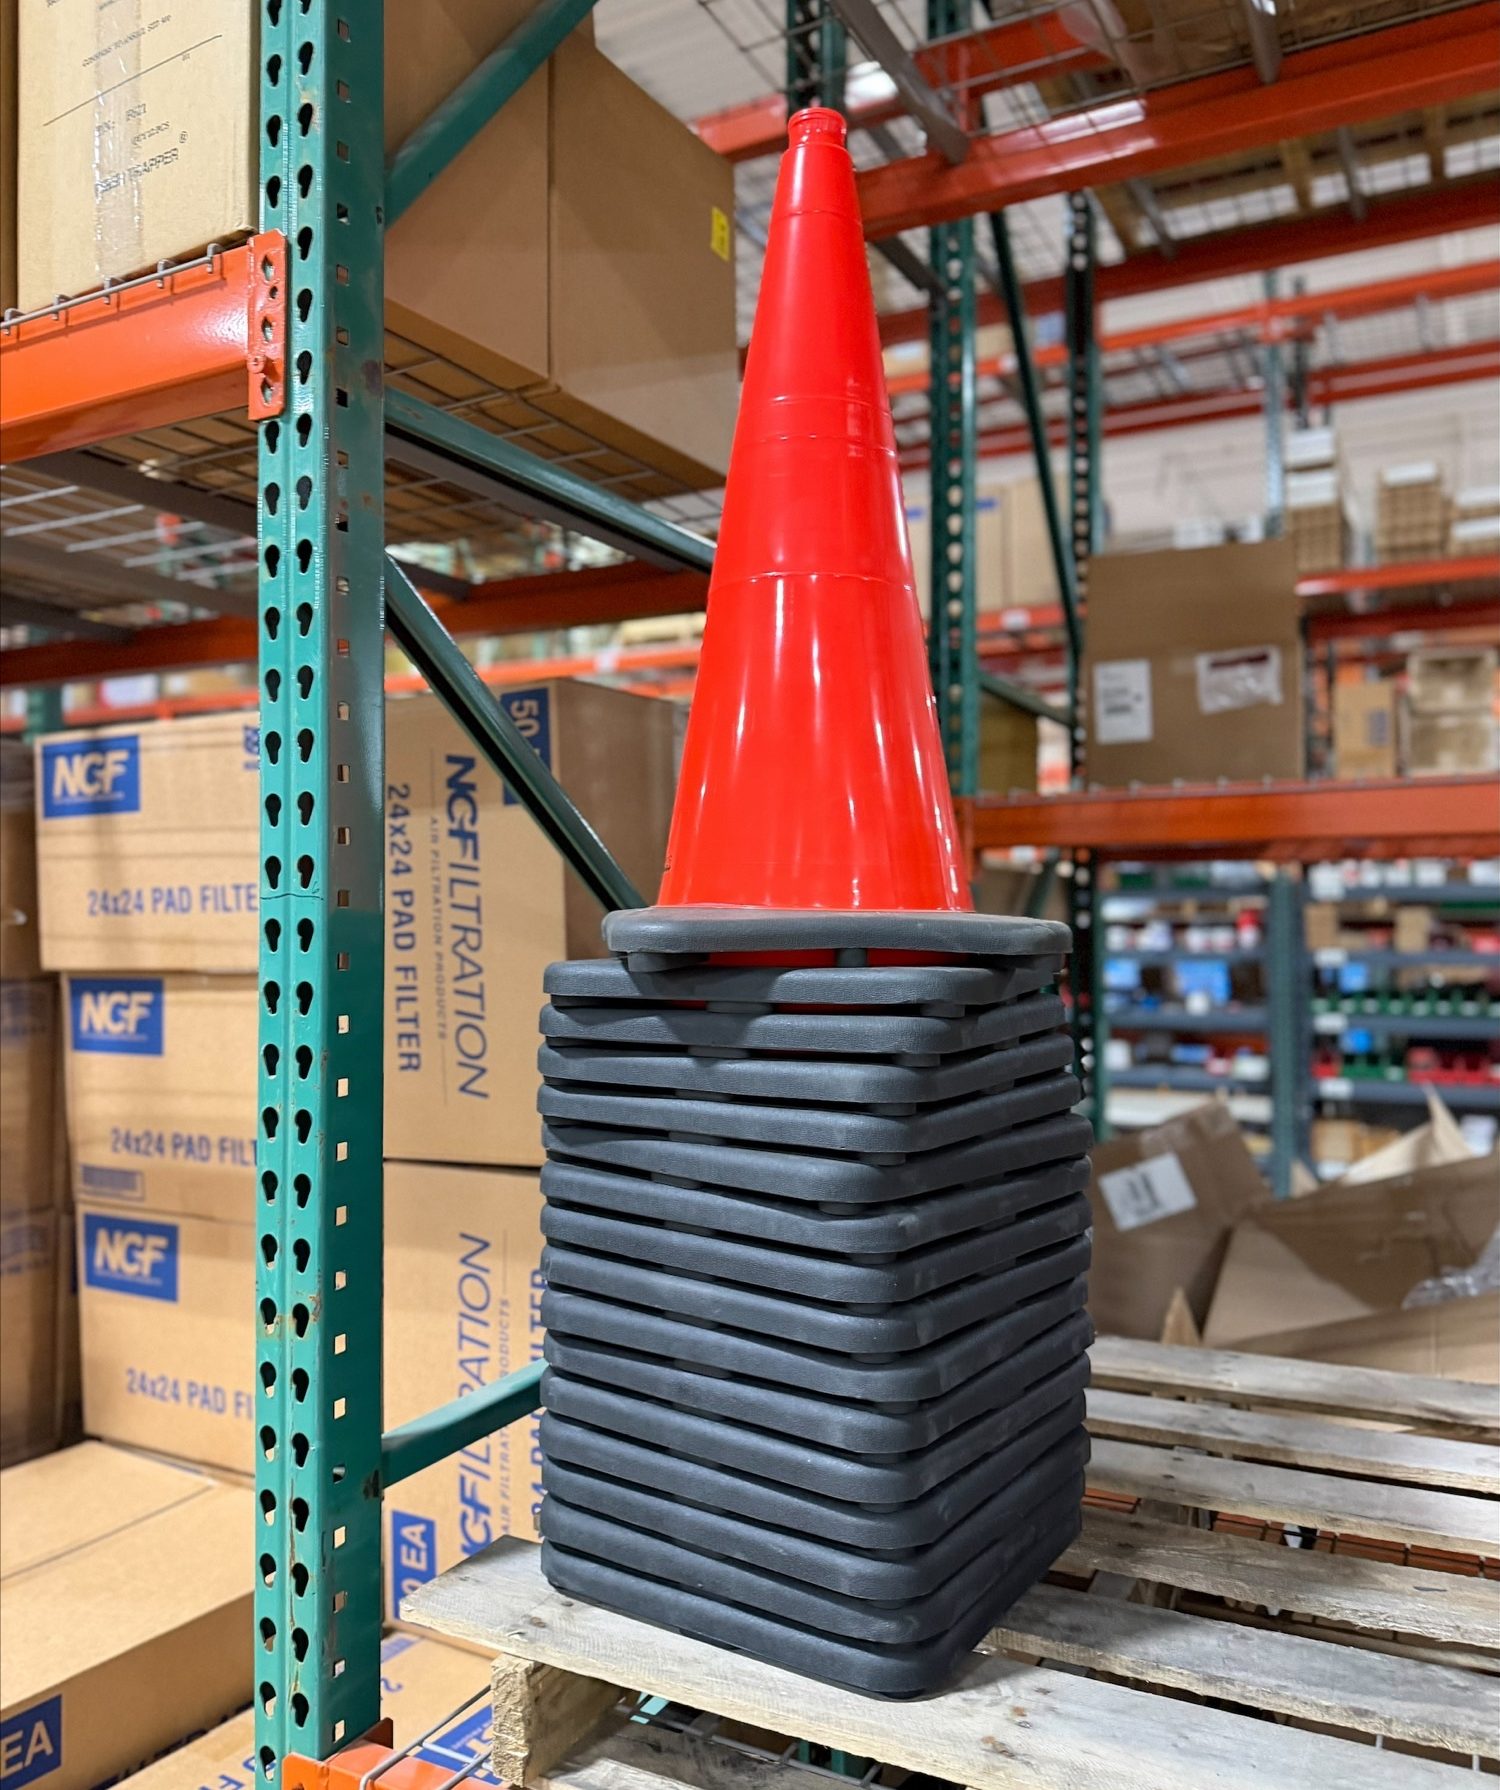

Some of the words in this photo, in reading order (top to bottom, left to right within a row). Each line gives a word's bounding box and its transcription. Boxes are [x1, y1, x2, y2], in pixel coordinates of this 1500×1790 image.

[388, 784, 413, 876] 24x24
[88, 887, 144, 916] 24x24
[151, 885, 192, 914] PAD
[392, 890, 416, 951] PAD
[395, 965, 421, 1072] FILTER
[111, 1127, 165, 1158] 24x24
[171, 1131, 211, 1161] PAD
[125, 1367, 181, 1403] 24x24
[187, 1380, 226, 1415] PAD
[401, 1523, 428, 1571] EA
[0, 1720, 54, 1779] EA
